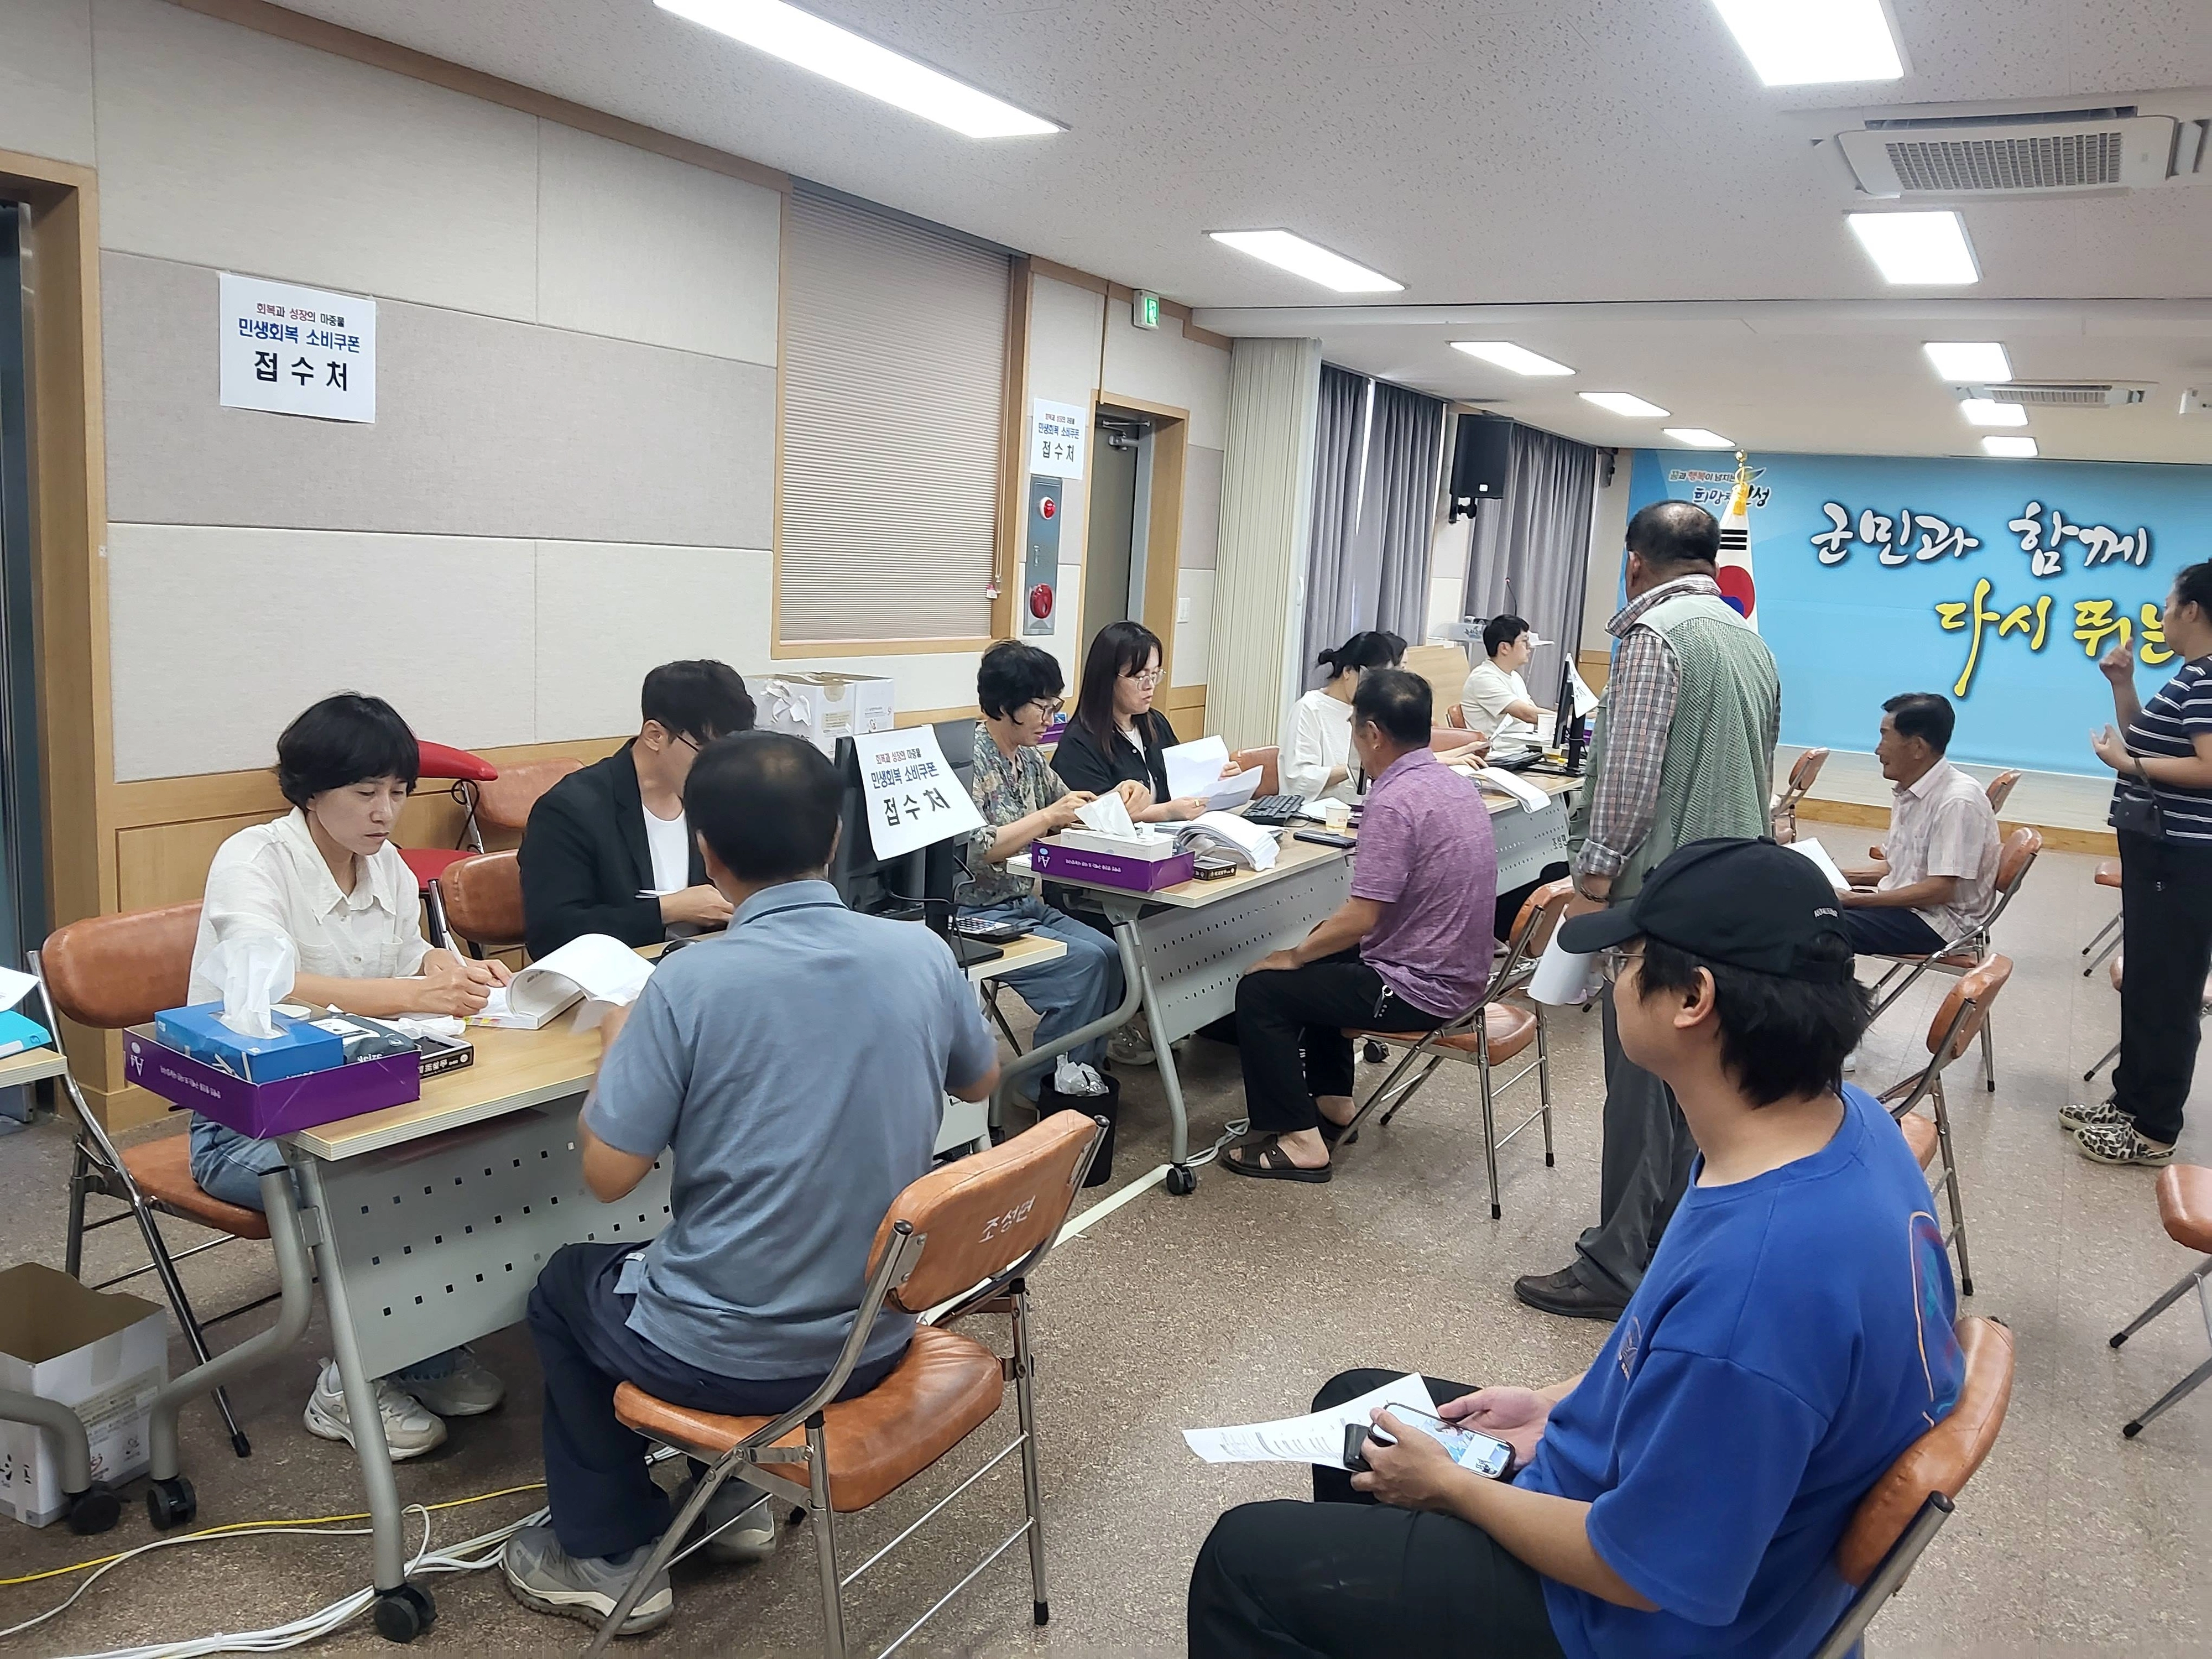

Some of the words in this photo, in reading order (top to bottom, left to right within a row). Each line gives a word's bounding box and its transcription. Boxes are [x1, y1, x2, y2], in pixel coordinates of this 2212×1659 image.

[257, 302, 285, 317] 회복과
[290, 308, 316, 322] 성장의
[321, 314, 345, 327] 마중물
[239, 318, 299, 344] 민생회복
[306, 329, 360, 353] 소비쿠폰
[1810, 502, 1979, 566] 군민과
[2008, 500, 2148, 576] 함께
[1935, 577, 2052, 698] 다시
[871, 768, 902, 789] 민생회복
[905, 761, 940, 782] 소비쿠폰
[129, 1055, 144, 1077] A4
[978, 1194, 1036, 1244] 조성면
